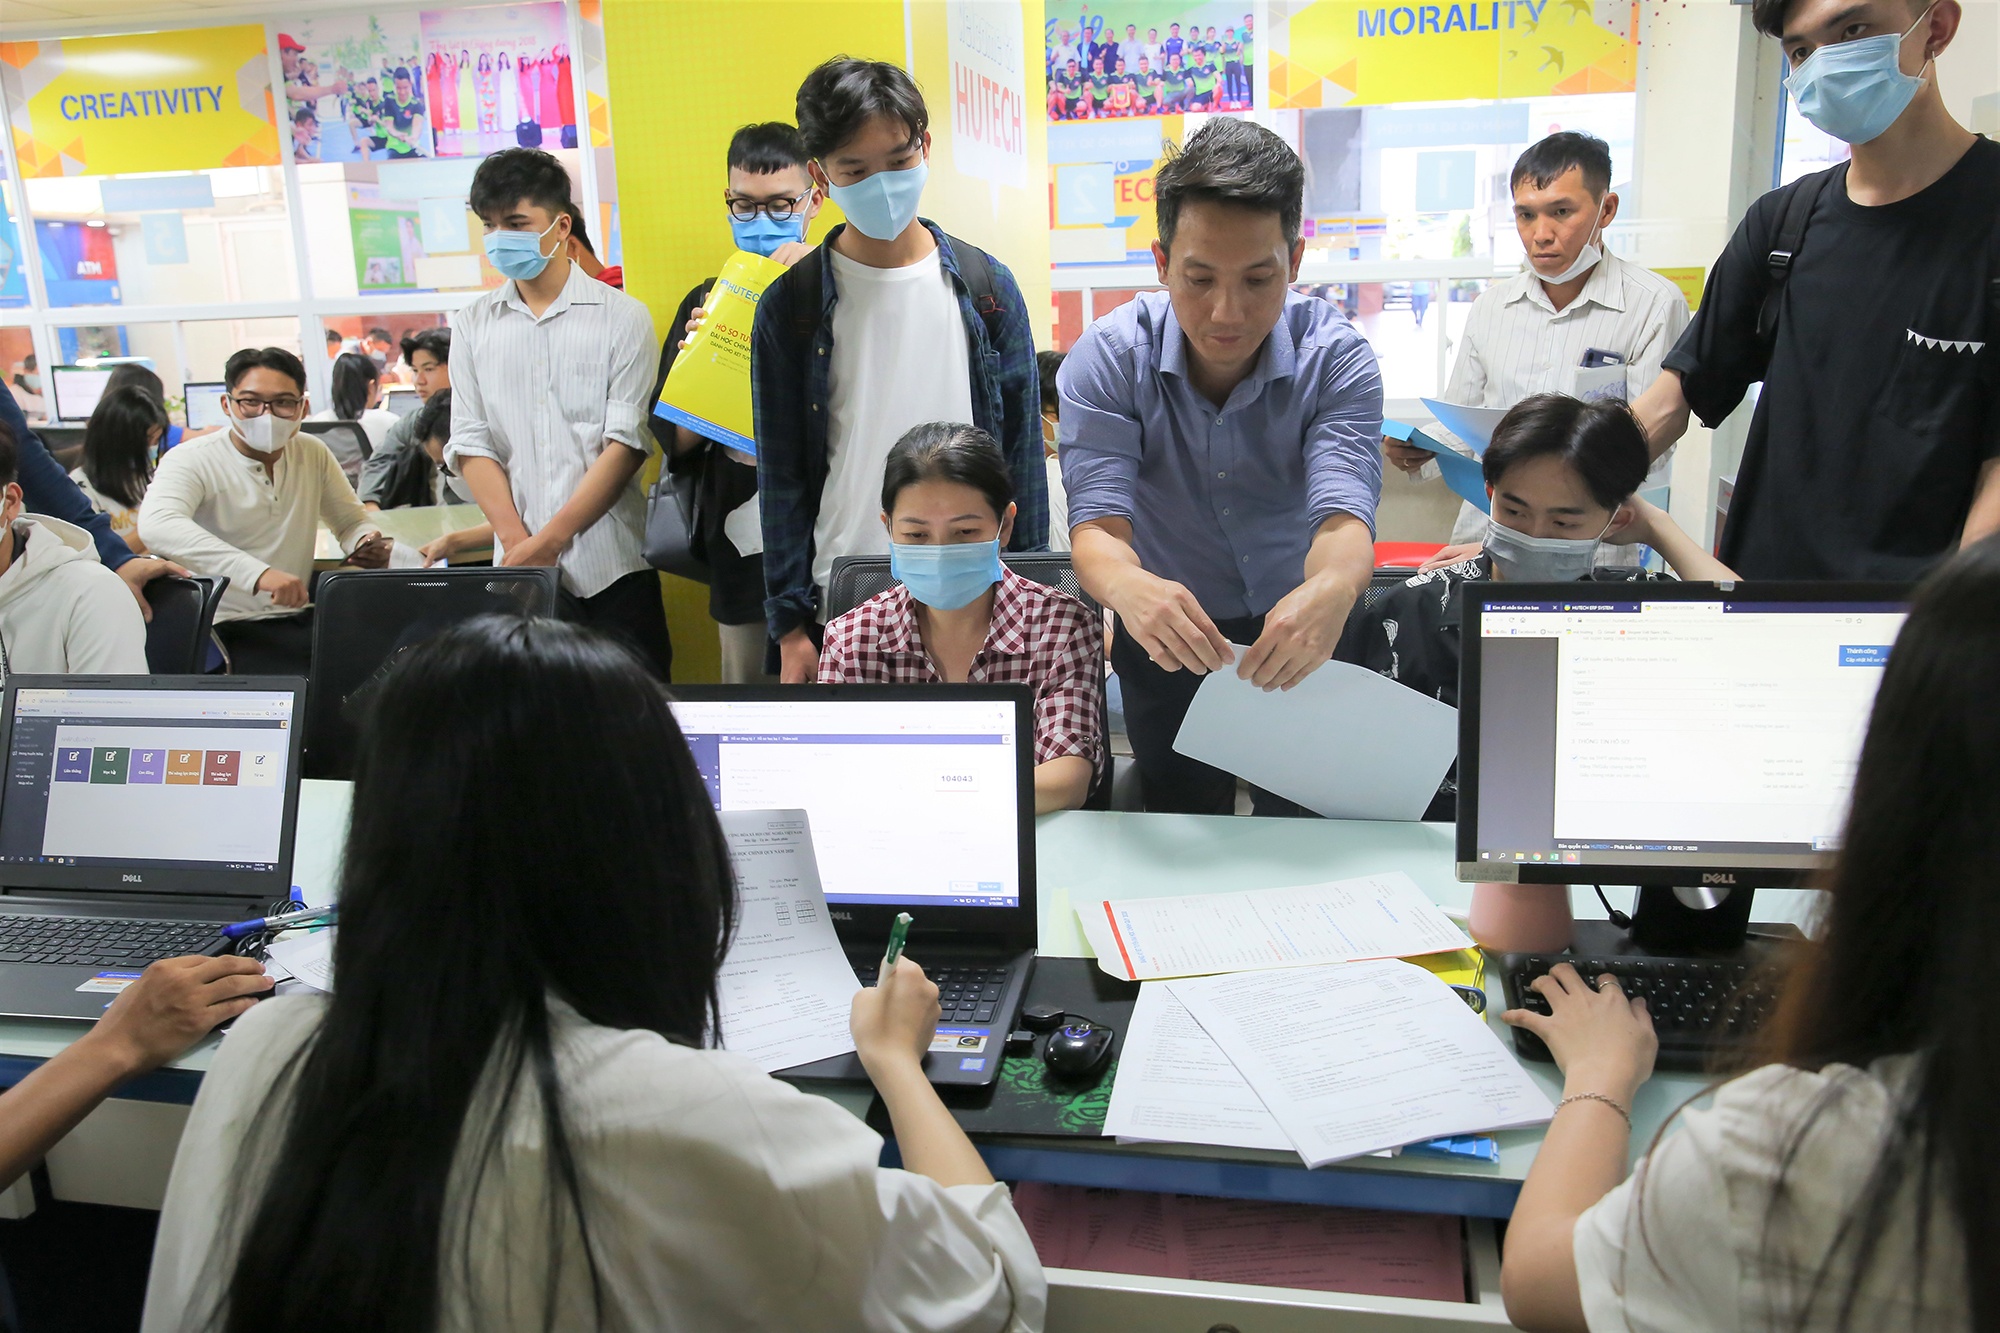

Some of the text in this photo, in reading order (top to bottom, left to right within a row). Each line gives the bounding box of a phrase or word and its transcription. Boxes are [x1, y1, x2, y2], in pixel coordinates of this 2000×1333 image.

[1357, 0, 1548, 37] MORALITY
[61, 85, 224, 121] CREATIVITY
[955, 61, 1022, 155] HUTECH
[77, 260, 102, 275] ATM
[941, 775, 973, 783] 104043
[122, 874, 142, 883] DELL
[1702, 873, 1736, 884] DELL
